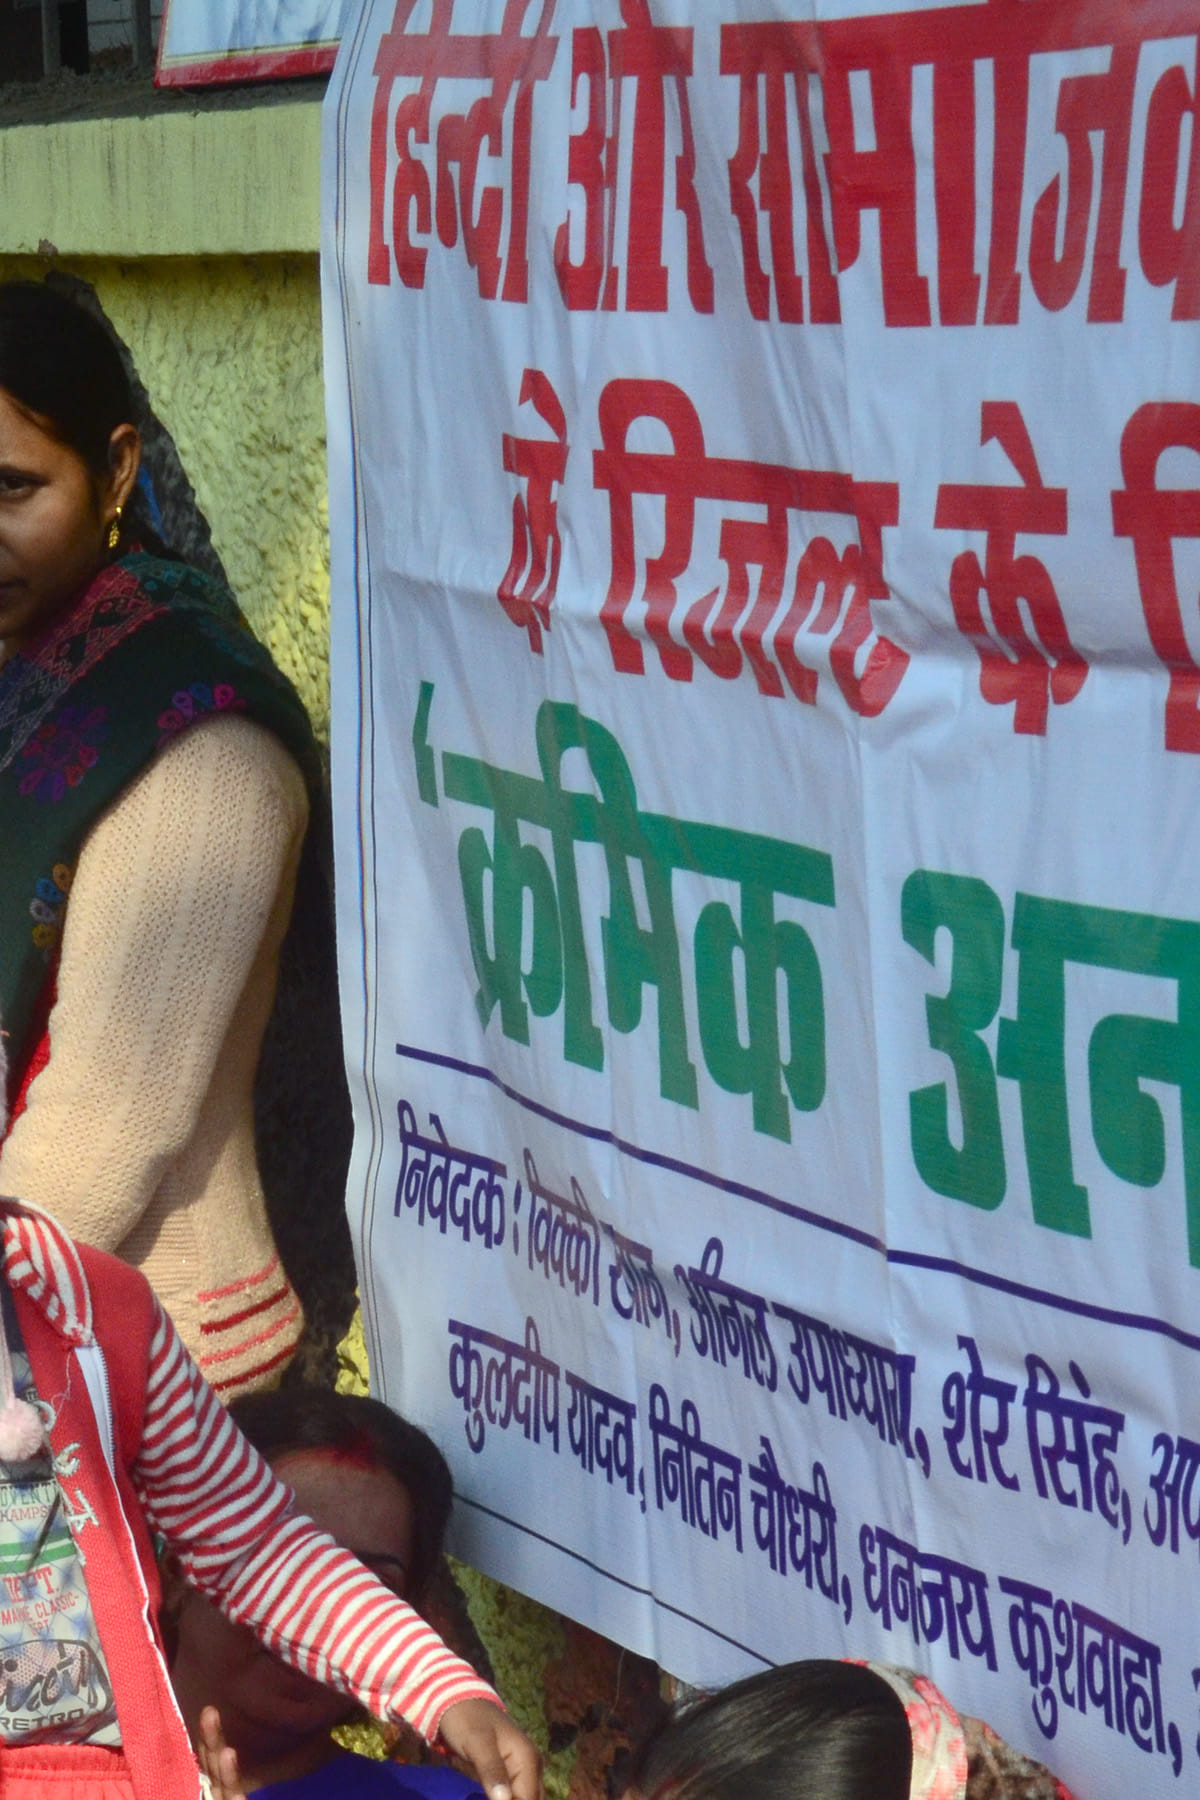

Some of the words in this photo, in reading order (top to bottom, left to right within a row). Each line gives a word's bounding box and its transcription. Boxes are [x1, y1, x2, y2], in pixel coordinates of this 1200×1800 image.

[497, 367, 570, 656] के
[933, 400, 1090, 736] के
[448, 1316, 560, 1453] कुलदीप
[565, 1369, 647, 1514] यादव,
[649, 1383, 744, 1553] नितिन
[748, 1435, 853, 1626] चौधरी,
[998, 1575, 1183, 1778] कुशवाहा,
[942, 1334, 1020, 1492] शेर
[1022, 1353, 1132, 1546] सिंह,
